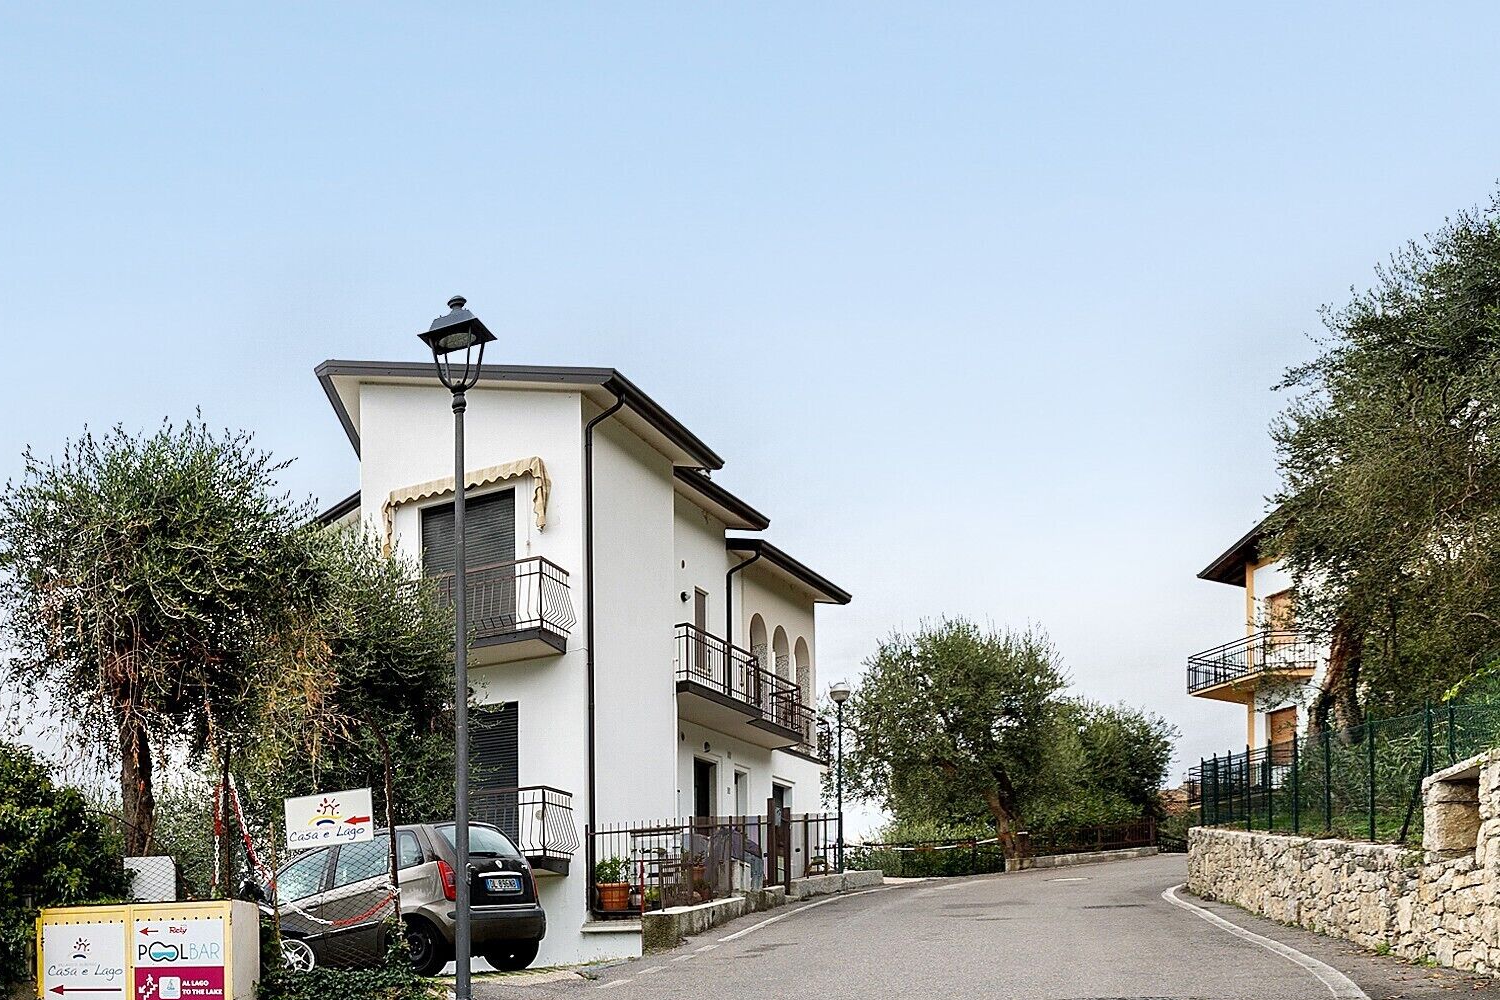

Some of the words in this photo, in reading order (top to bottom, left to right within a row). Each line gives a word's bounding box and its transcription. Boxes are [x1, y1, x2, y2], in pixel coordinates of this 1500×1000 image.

[289, 831, 319, 842] Casa
[336, 826, 365, 841] Lago
[47, 965, 78, 977] Casa
[81, 968, 89, 976] e
[94, 963, 123, 981] Lago
